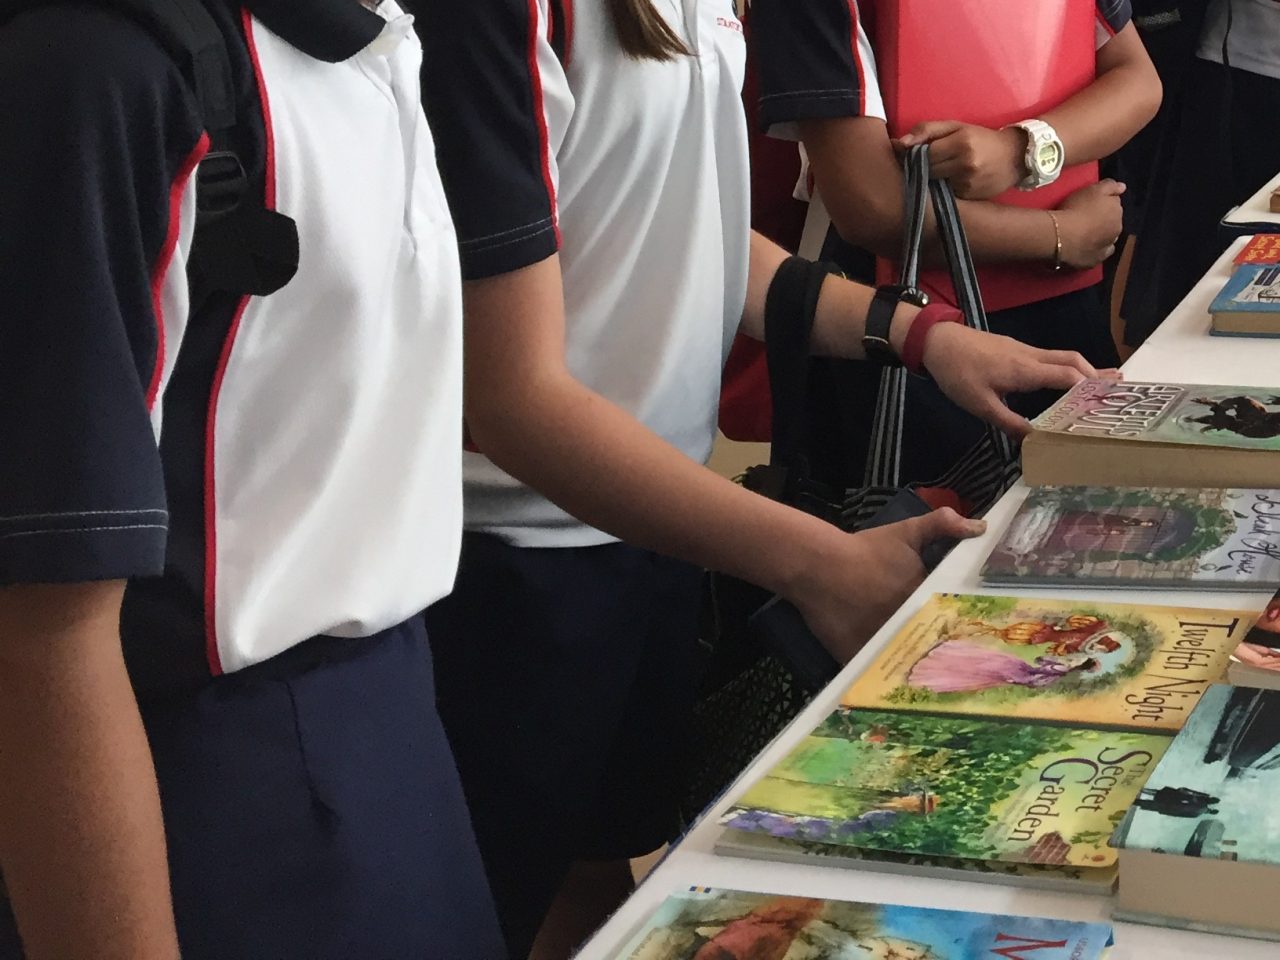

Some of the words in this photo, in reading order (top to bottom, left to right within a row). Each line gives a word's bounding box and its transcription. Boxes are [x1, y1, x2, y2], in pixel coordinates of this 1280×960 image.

[1064, 382, 1156, 434] FOWL
[1107, 384, 1184, 437] ARTEMIS
[1159, 617, 1240, 674] Twelfth
[1124, 673, 1208, 722] Night
[1007, 757, 1099, 842] Garden
[1075, 746, 1153, 813] Secret
